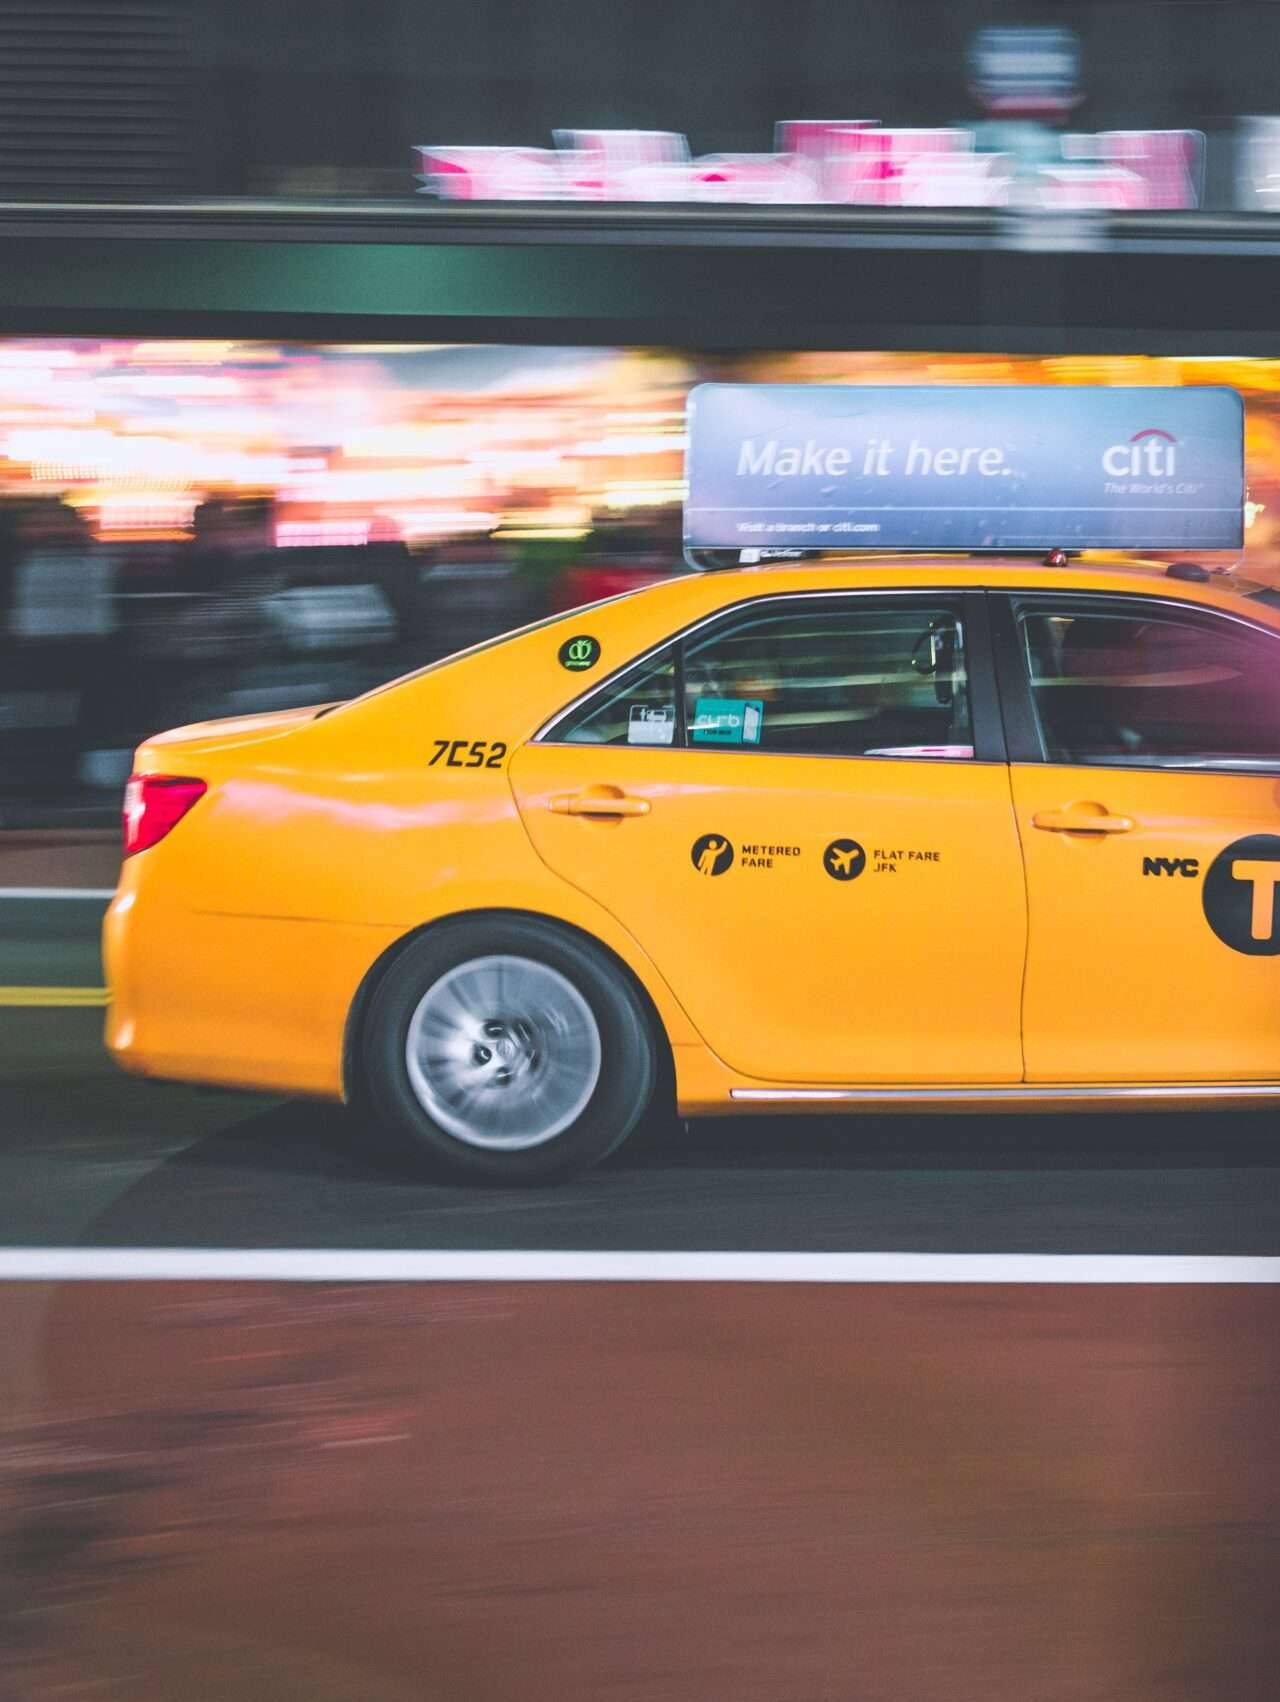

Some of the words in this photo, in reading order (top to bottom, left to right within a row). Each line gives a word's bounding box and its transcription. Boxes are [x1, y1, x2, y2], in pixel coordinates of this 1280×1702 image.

[736, 440, 853, 476] Make
[863, 439, 896, 476] it
[905, 439, 1013, 476] here.
[1102, 439, 1176, 477] citi
[1104, 482, 1126, 495] The
[428, 740, 507, 769] 7C52
[741, 845, 801, 857] METERED
[873, 849, 905, 861] FLAT
[908, 850, 941, 862] FARE
[741, 857, 774, 869] FARE
[873, 863, 898, 874] JFK
[1143, 857, 1198, 877] NYC
